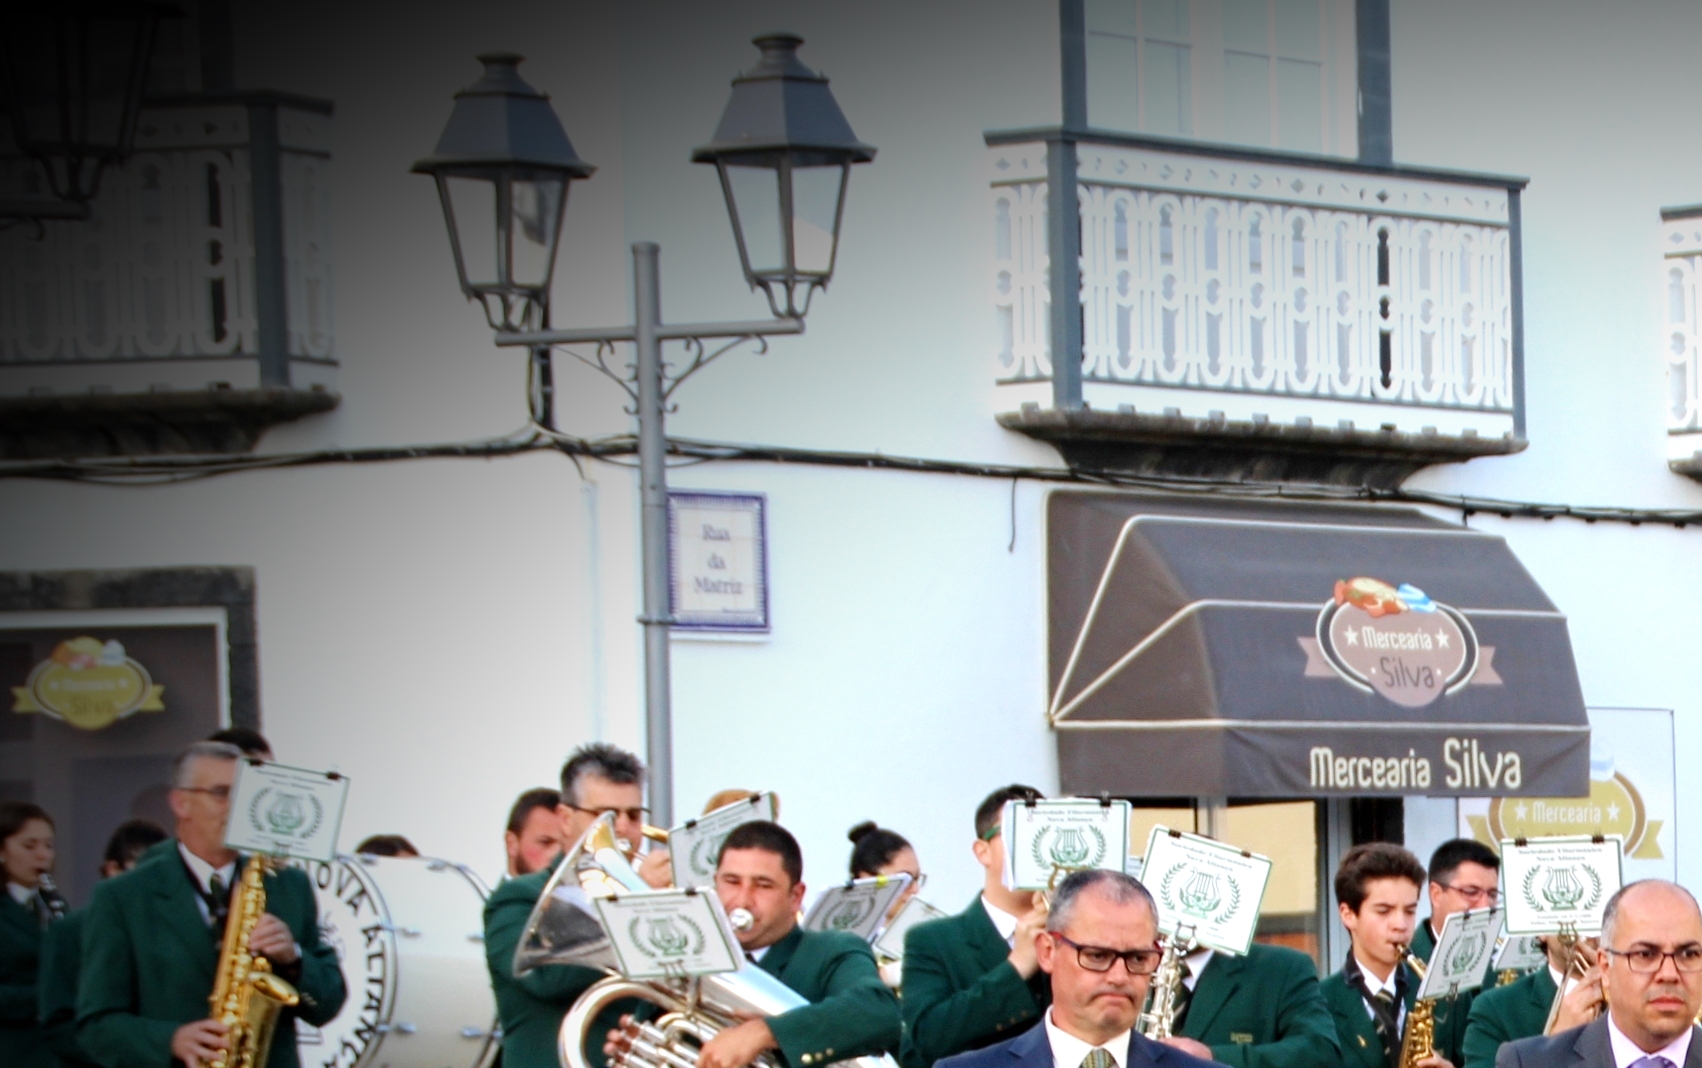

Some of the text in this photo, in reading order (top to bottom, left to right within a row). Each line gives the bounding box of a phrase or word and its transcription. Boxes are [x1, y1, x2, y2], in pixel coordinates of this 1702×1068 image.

[703, 524, 731, 541] Rua
[707, 552, 726, 569] da
[1361, 626, 1433, 650] Mercearia
[1379, 656, 1435, 688] Silva
[1310, 737, 1521, 789] Mercearia Silva
[1533, 801, 1602, 824] Mercearia
